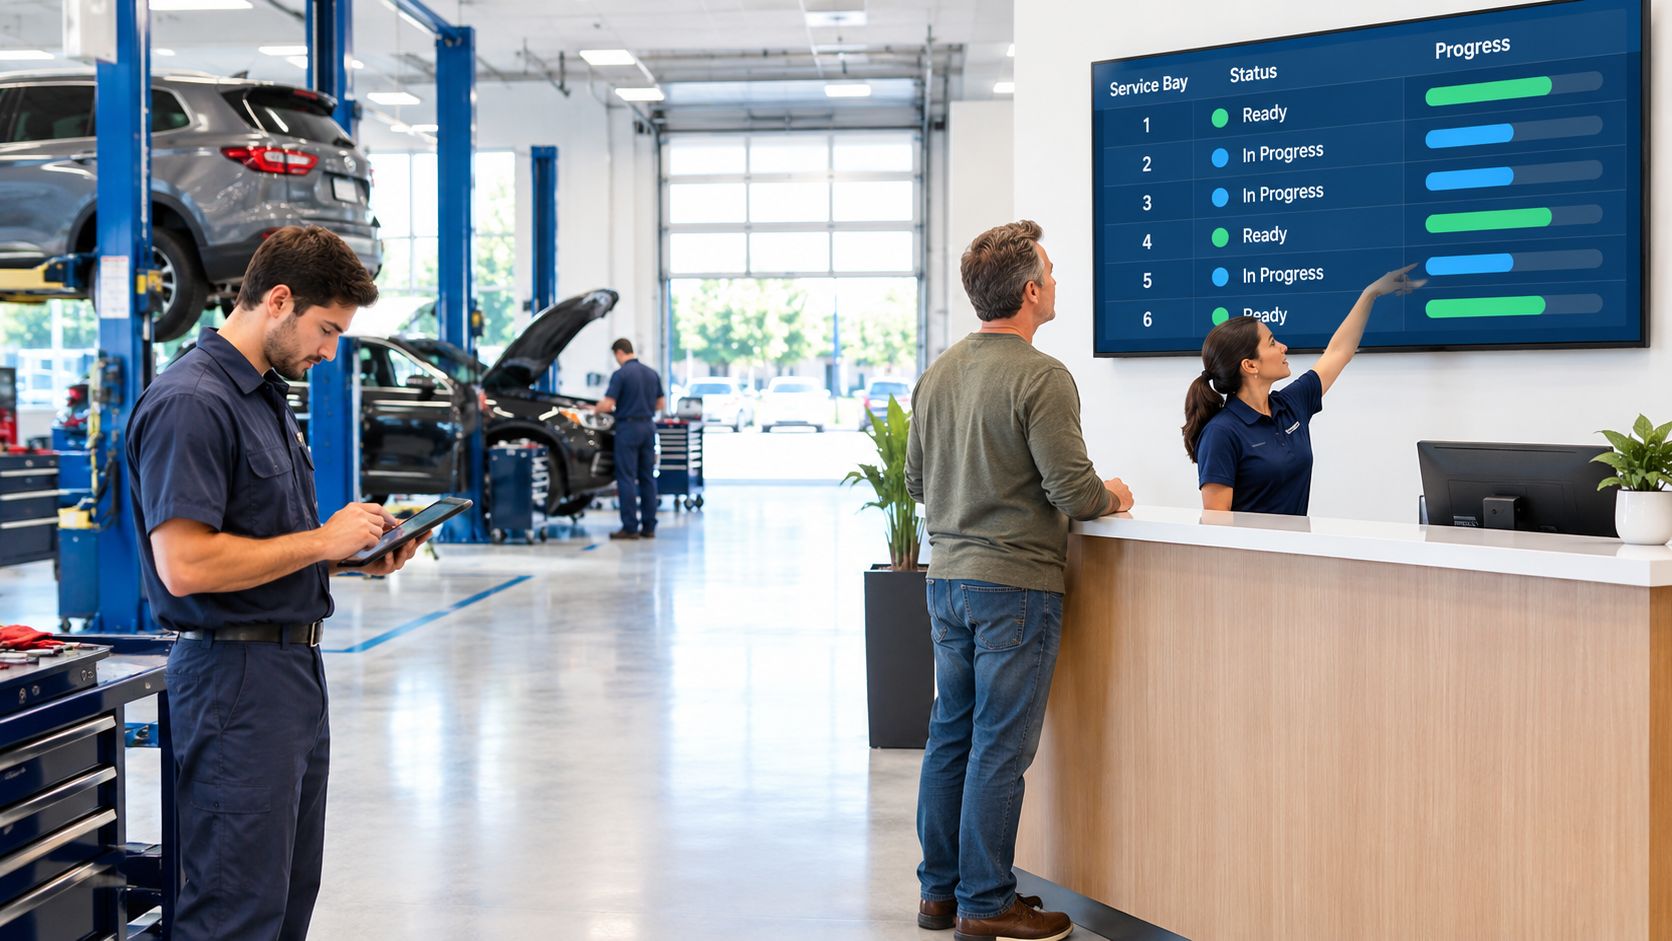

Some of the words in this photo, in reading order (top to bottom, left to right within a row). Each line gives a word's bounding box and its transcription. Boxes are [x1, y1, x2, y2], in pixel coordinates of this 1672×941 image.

[1435, 36, 1511, 61] Progress
[1230, 65, 1278, 84] Status
[1109, 79, 1160, 97] Service
[1162, 75, 1189, 94] Bay
[1243, 103, 1288, 124] Ready
[1142, 117, 1150, 133] 1
[1142, 155, 1152, 172] 2
[1243, 147, 1256, 163] In
[1260, 144, 1324, 164] Progress
[1142, 194, 1152, 211] 3
[1243, 187, 1256, 203] In
[1260, 185, 1324, 204] Progress
[1142, 233, 1153, 250] 4
[1243, 225, 1288, 246] Ready
[1142, 272, 1152, 289] 5
[1243, 268, 1256, 284] In
[1260, 266, 1324, 286] Progress
[1142, 311, 1153, 328] 6
